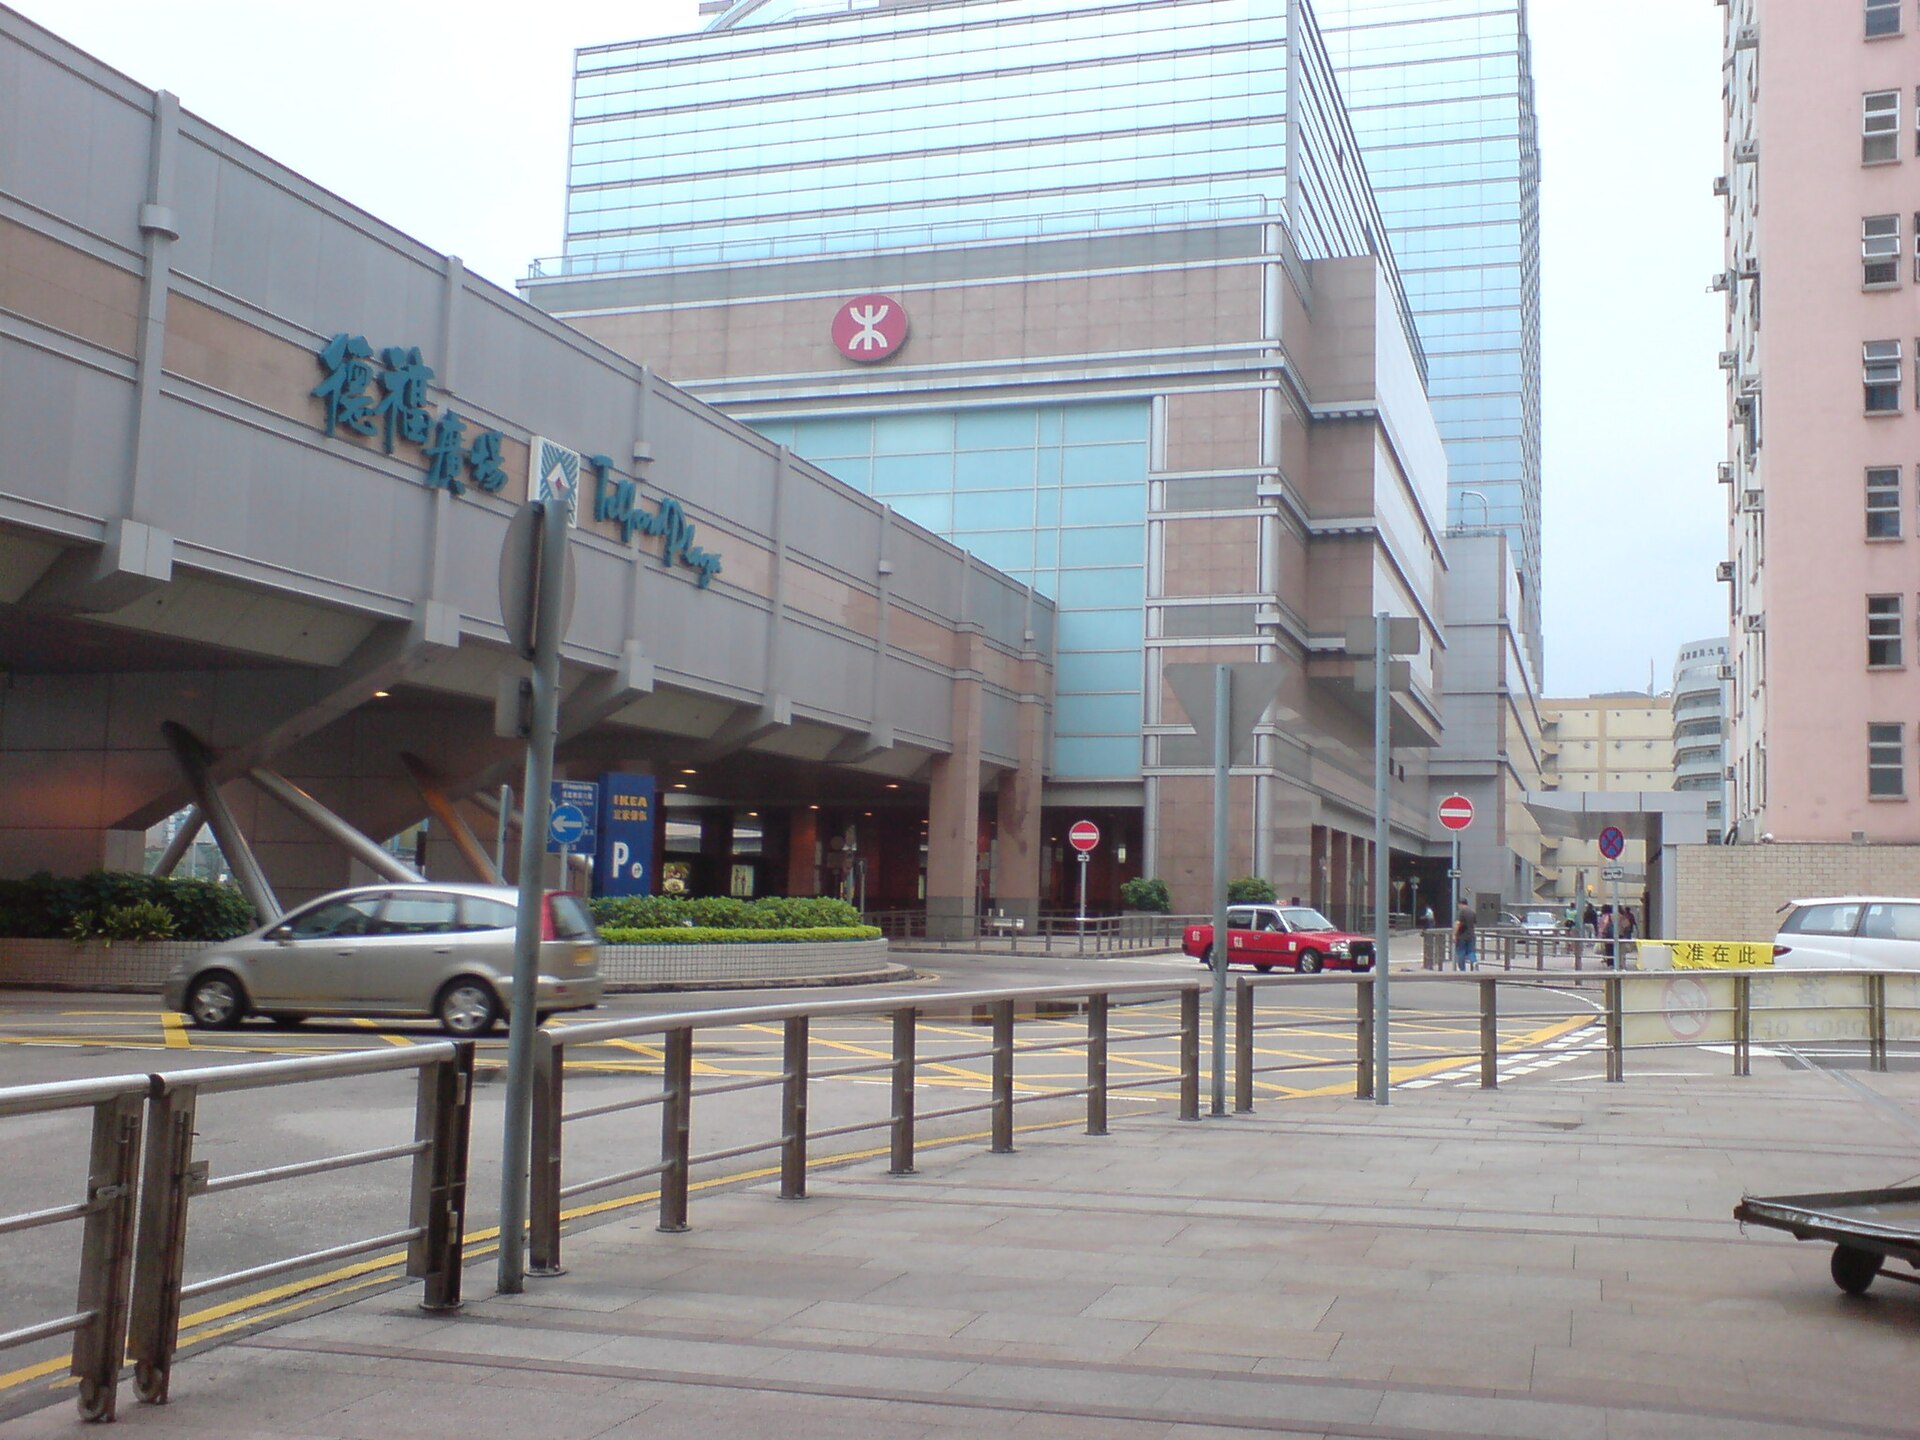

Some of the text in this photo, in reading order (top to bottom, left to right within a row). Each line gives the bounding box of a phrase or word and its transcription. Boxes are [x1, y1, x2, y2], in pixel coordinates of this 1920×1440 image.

[311, 333, 508, 496] 德福廣場
[613, 794, 648, 808] IKEA
[612, 842, 629, 878] P
